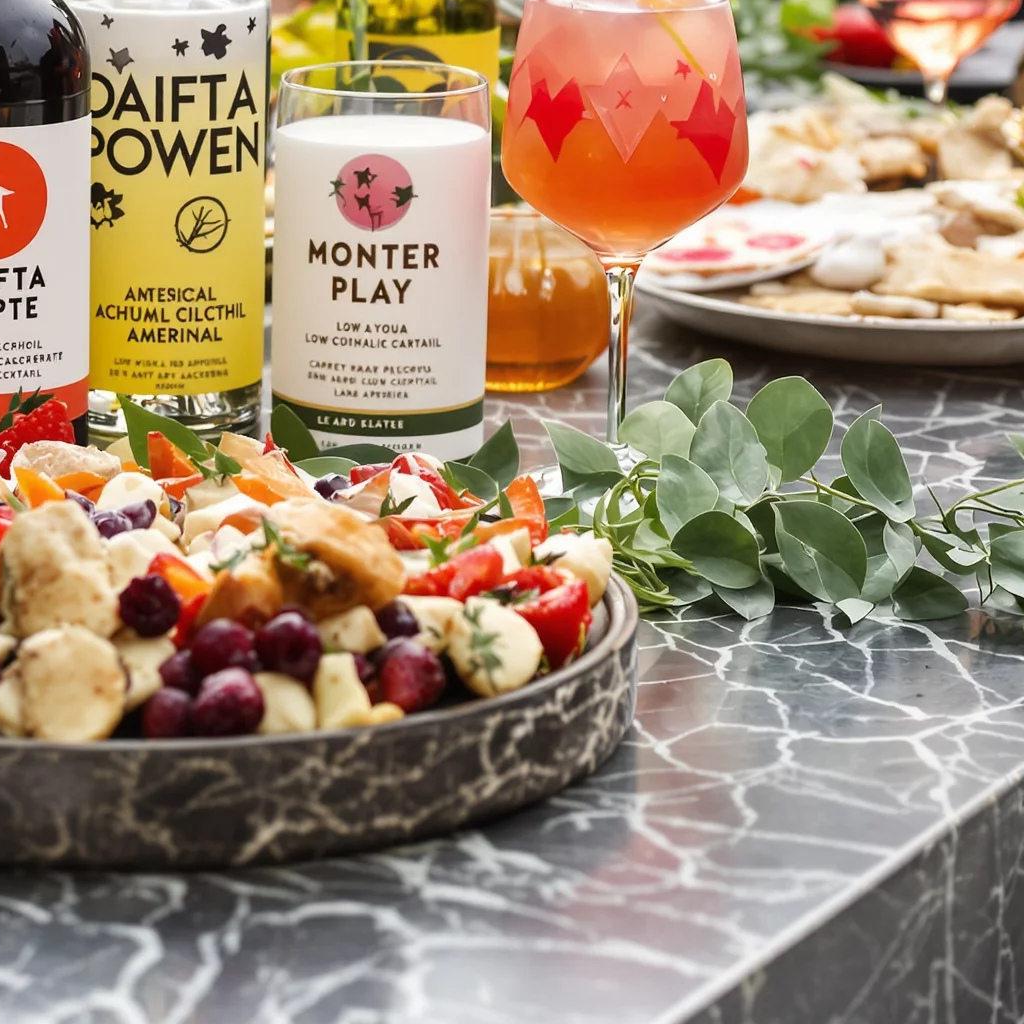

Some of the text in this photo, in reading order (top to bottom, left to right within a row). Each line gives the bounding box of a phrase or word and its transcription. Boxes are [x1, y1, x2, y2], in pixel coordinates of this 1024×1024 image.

[308, 238, 440, 269] MONTER
[332, 276, 412, 304] PLAY
[336, 321, 361, 332] LOW
[127, 327, 223, 343] AMERINAL
[305, 333, 328, 344] LOW
